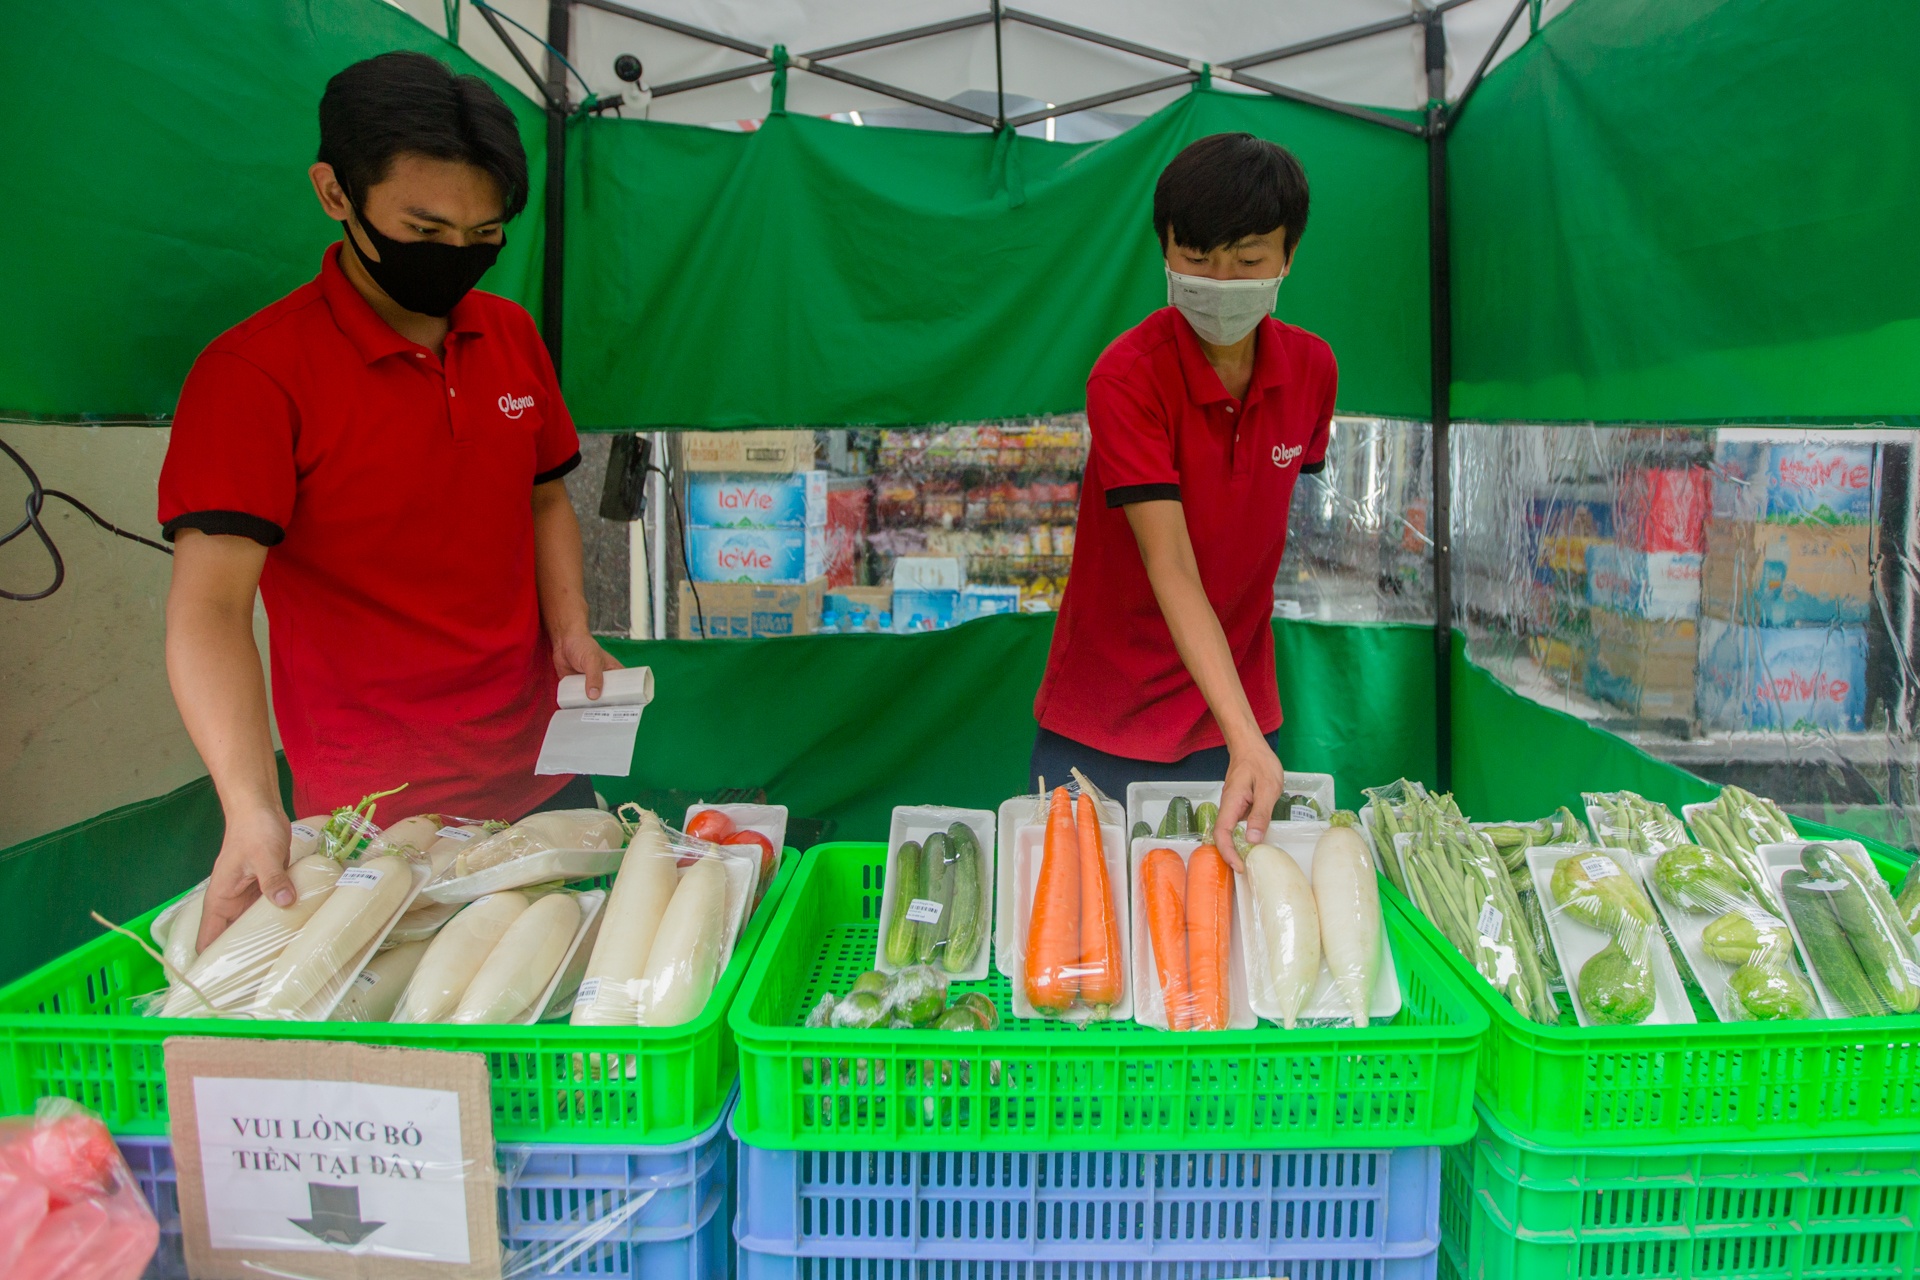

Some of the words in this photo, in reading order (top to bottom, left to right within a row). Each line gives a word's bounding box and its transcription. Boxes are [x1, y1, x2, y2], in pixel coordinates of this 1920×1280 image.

[231, 1117, 282, 1138] VUI
[292, 1113, 376, 1142] LÒNG
[384, 1121, 423, 1147] BỎ
[310, 1152, 359, 1180] TẠI
